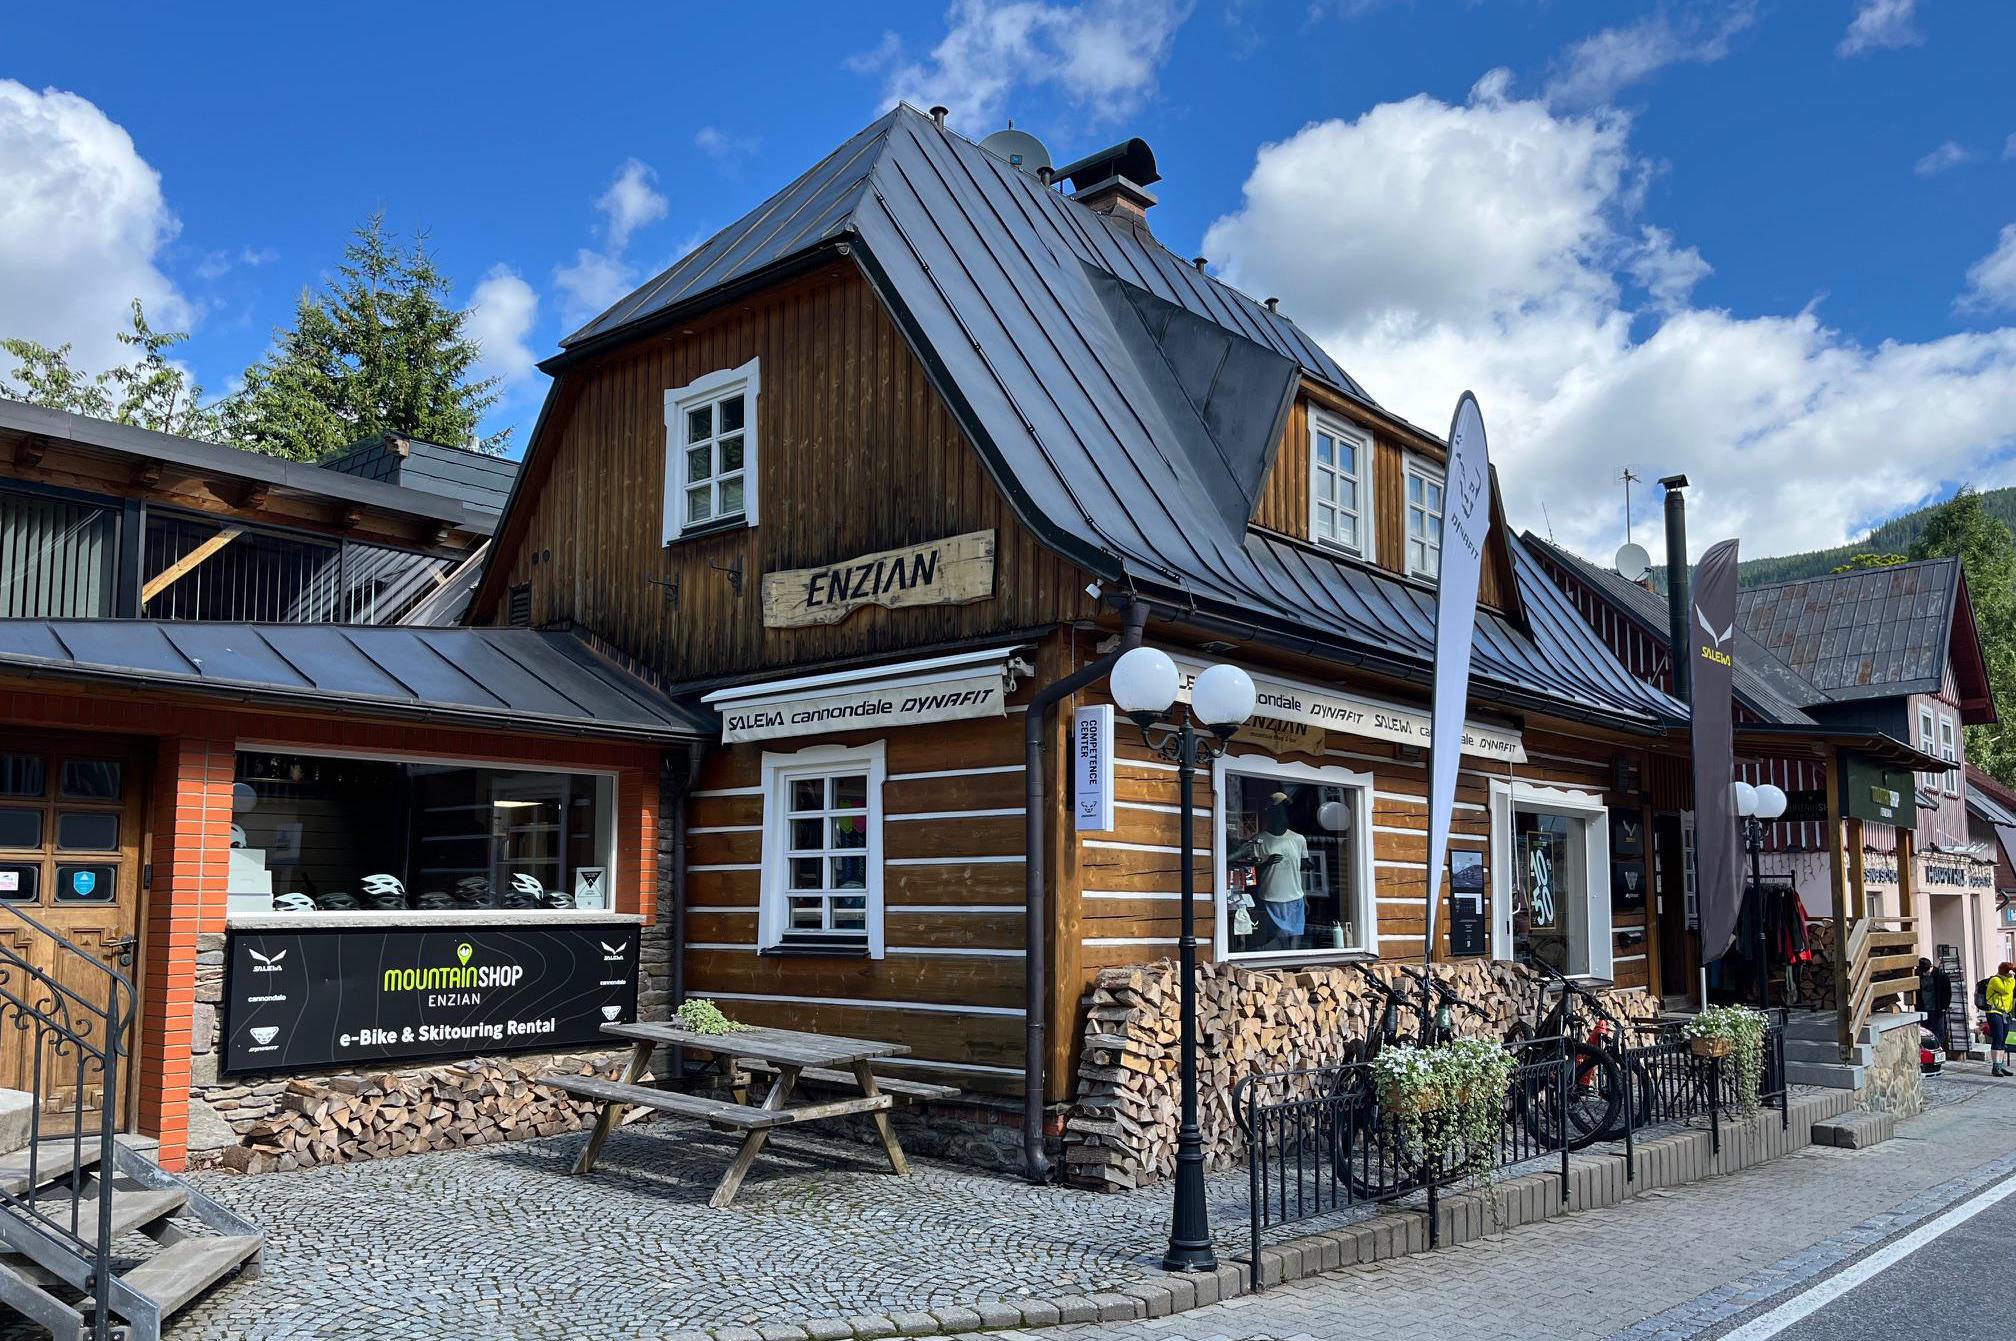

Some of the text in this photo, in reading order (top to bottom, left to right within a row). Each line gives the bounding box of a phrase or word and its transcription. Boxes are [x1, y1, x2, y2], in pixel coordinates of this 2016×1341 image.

[1451, 513, 1479, 561] DYNAFIT
[806, 550, 938, 607] ENZIAN
[1701, 645, 1731, 667] SALEWA
[728, 688, 994, 732] SALEWA cannondale DYNAFIT
[1310, 703, 1364, 724] DYNAFIT
[1374, 713, 1412, 734] SALEWA
[1479, 737, 1516, 753] DYNAFIT
[1080, 720, 1089, 758] CENTER
[1089, 719, 1098, 785] COMPETENCE
[252, 964, 283, 973] SALEWA
[247, 993, 287, 1003] cannondale
[428, 992, 481, 1007] ENZIAN
[339, 1017, 556, 1047] e-Bike & Skitouring Rental
